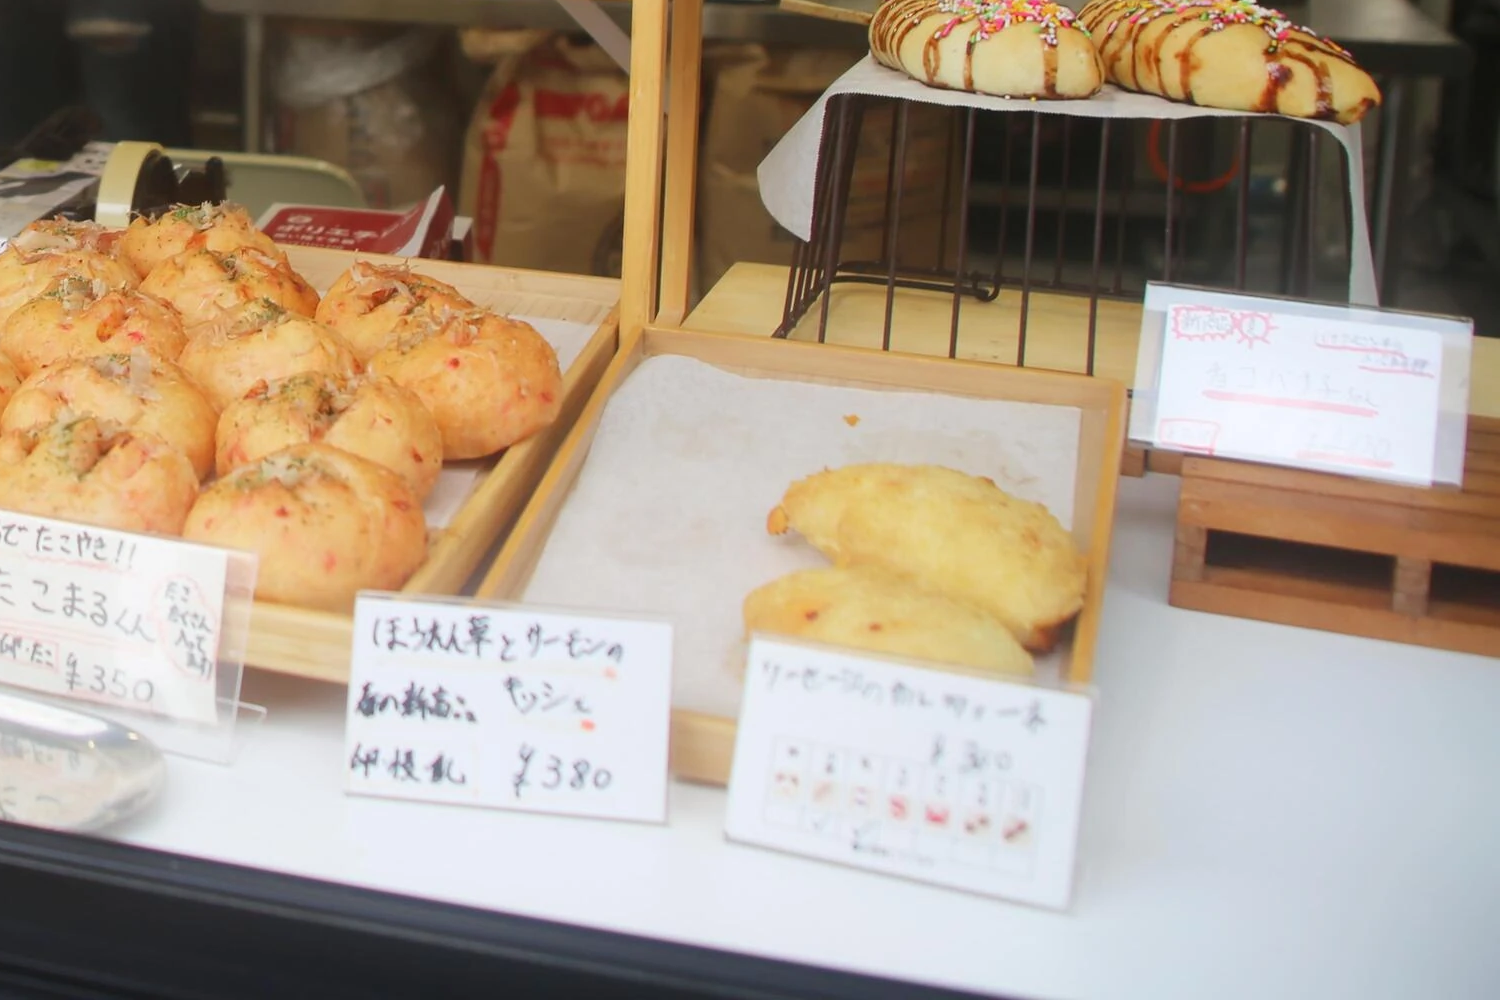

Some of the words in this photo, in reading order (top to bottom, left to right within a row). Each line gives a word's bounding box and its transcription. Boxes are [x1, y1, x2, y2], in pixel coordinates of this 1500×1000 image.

[373, 616, 625, 663] ほうれん草とサーモンの
[65, 652, 155, 703] ¥350
[511, 743, 613, 798] ¥380
